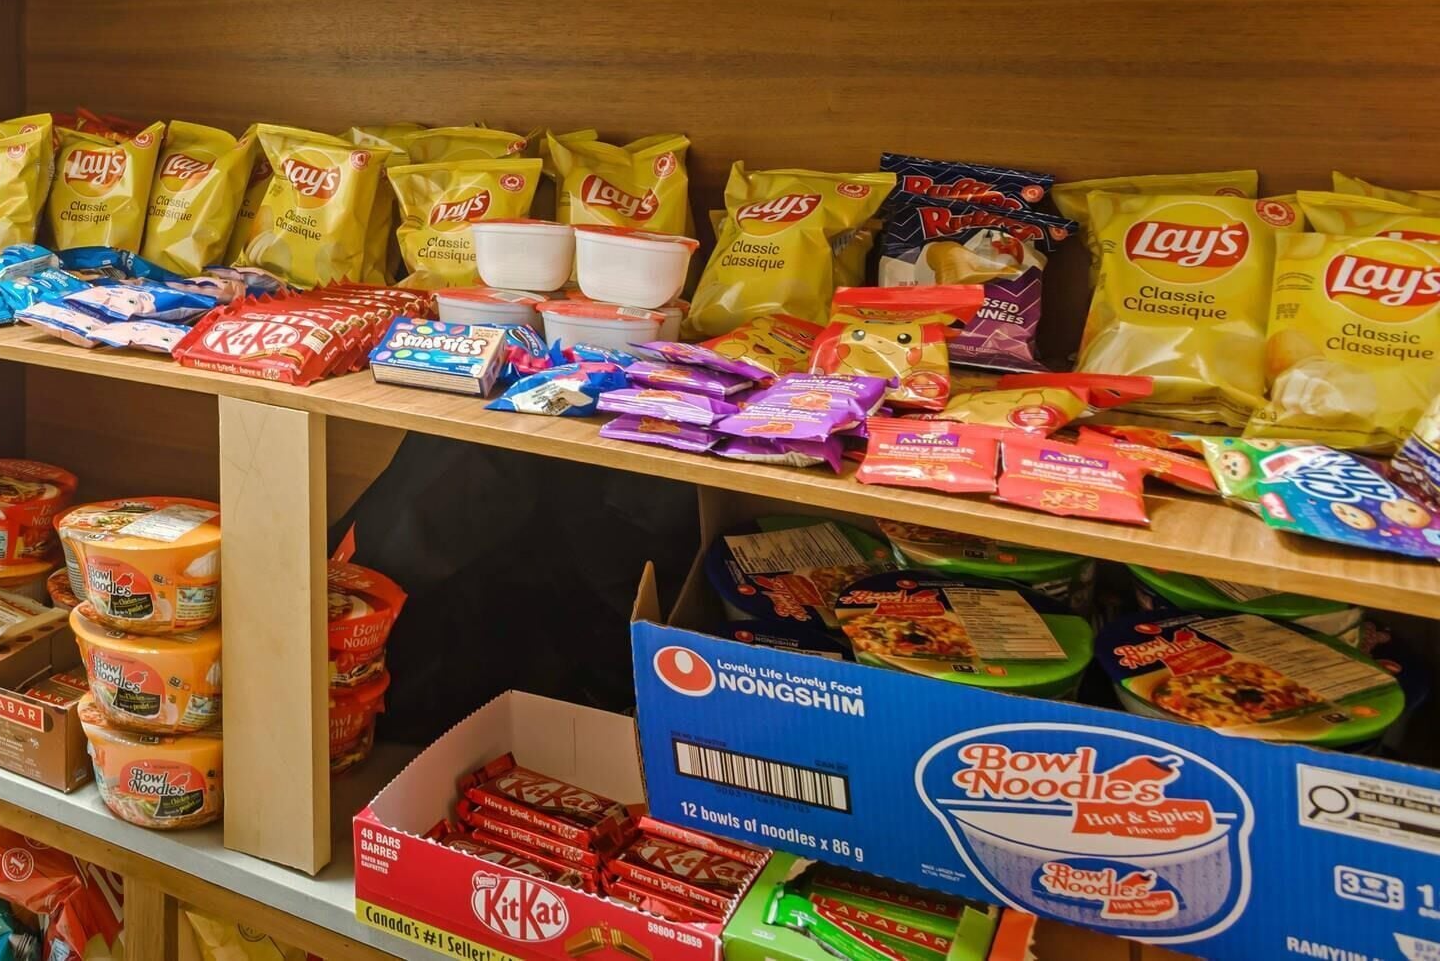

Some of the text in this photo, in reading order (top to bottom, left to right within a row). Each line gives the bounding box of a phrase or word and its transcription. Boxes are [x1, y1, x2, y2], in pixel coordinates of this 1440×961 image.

[67, 151, 124, 184] Lay's
[60, 211, 110, 224] Classique
[70, 201, 107, 211] Classic
[284, 208, 318, 228] Classic
[275, 216, 322, 241] Classique
[426, 236, 470, 248] Classic
[732, 240, 780, 256] Classic
[1131, 222, 1240, 268] Lay's
[417, 247, 477, 264] Classique
[721, 255, 785, 271] Classique
[1331, 256, 1440, 305] Lay's
[1139, 286, 1216, 305] Classic
[1123, 297, 1228, 321] Classique
[390, 332, 487, 356] SMARTIES
[1341, 323, 1421, 345] Classic
[1326, 337, 1434, 361] Classique
[94, 669, 141, 693] Noodles
[717, 659, 863, 697] Lovely Life Lovely Food
[718, 671, 865, 717] NONGSHIM
[959, 744, 1095, 775] Bowl
[128, 779, 186, 796] Noodles
[131, 767, 168, 784] Bowl
[954, 769, 1165, 804] Noodles
[1083, 805, 1207, 827] Hot & Spicy
[361, 828, 401, 849] 48 BARS
[681, 801, 864, 863] 12 bowls of noodles x 86 g
[1126, 824, 1177, 837] Flavour
[361, 840, 398, 861] BARRES
[1043, 861, 1116, 884] Bowl
[630, 869, 709, 904] Have break, have
[1041, 875, 1151, 899] Noodles
[484, 888, 562, 936] KitKat
[366, 906, 490, 961] Canada's #1 Seller!
[647, 921, 703, 949] 59800 21859
